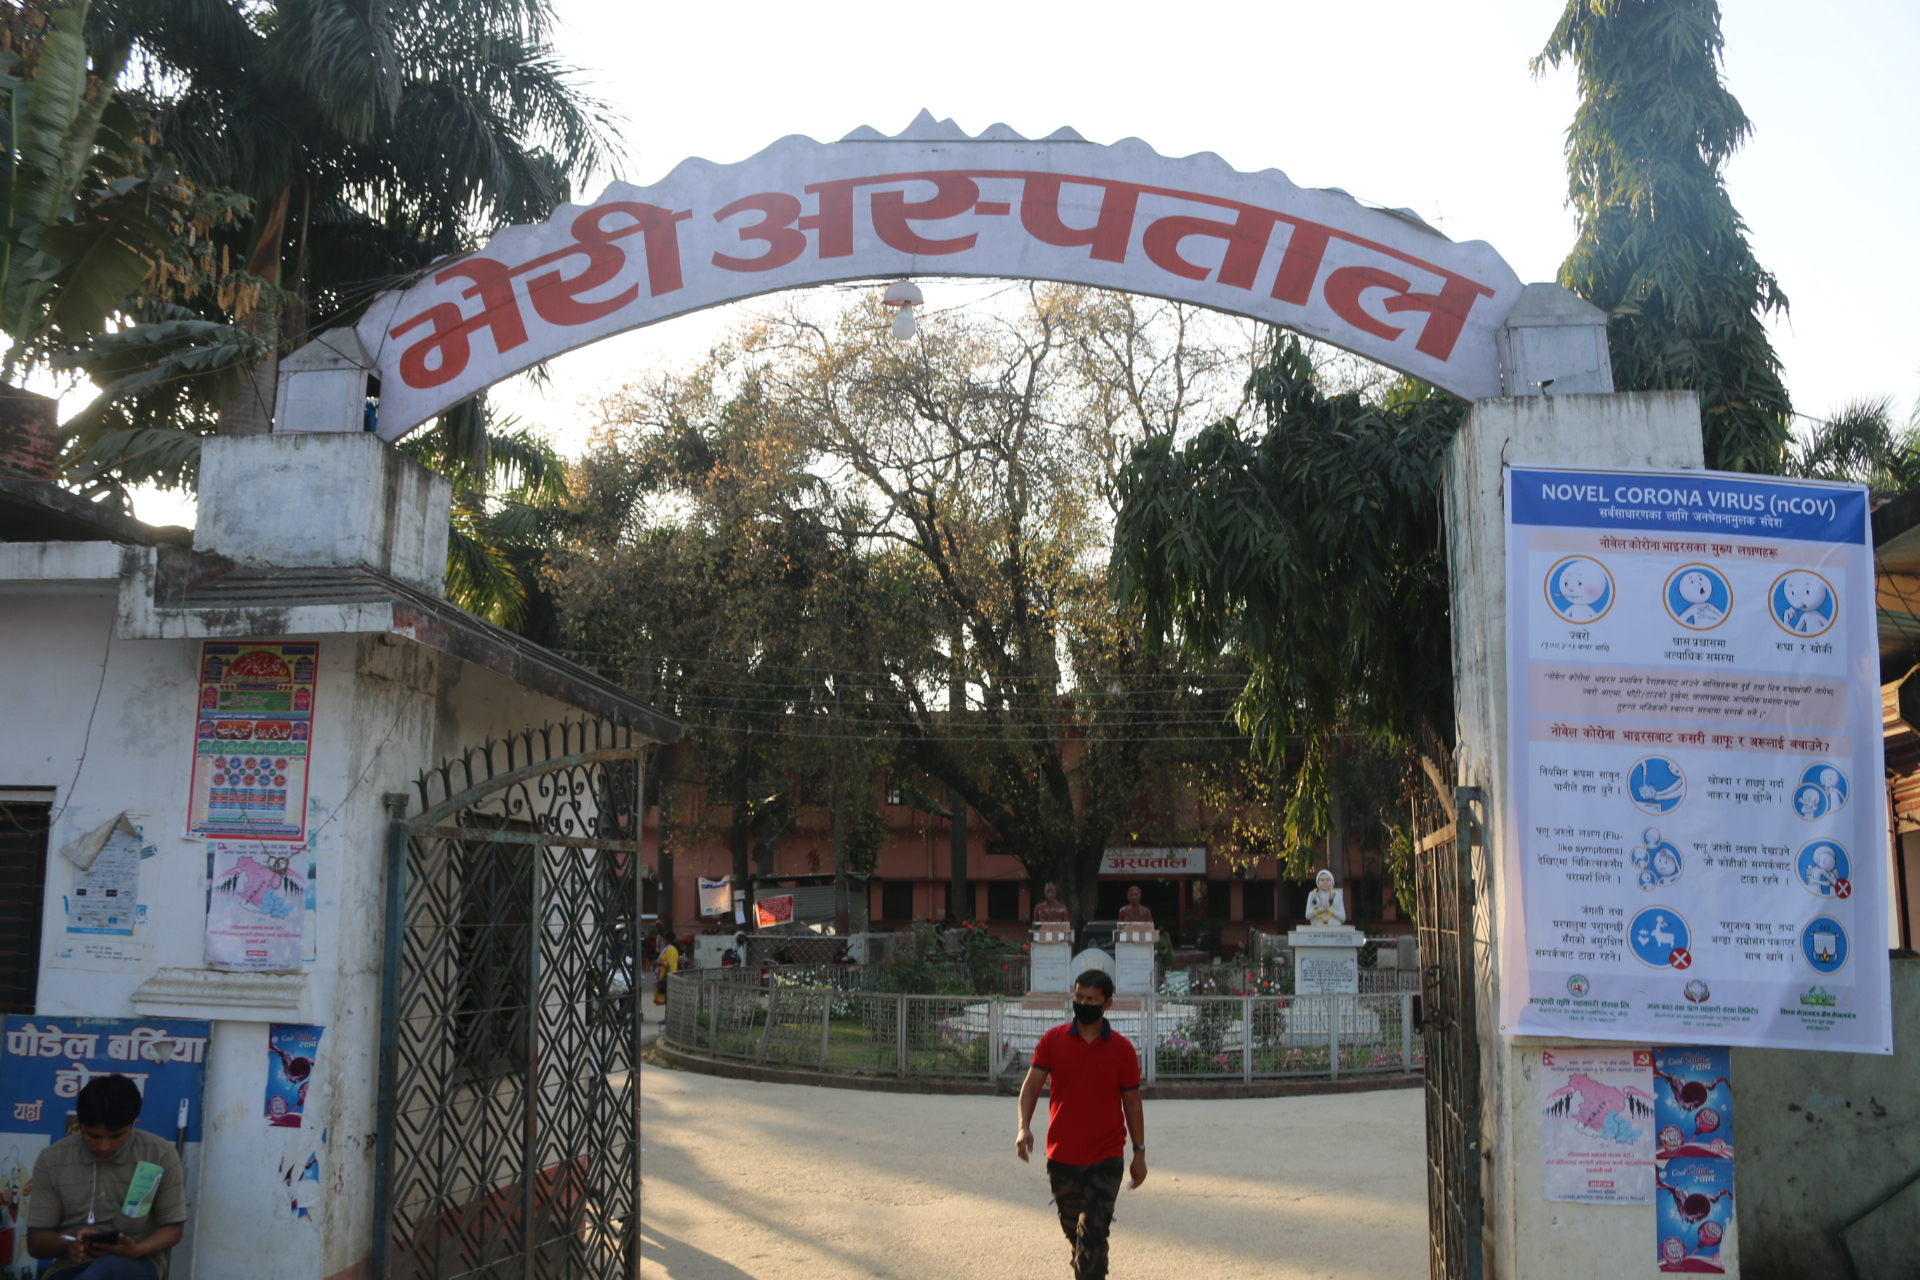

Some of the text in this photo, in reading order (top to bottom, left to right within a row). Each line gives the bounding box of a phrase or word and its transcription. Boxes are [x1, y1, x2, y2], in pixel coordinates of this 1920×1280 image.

[389, 170, 1496, 389] भेरी अस्पताल
[1542, 483, 1836, 521] NOVEL CORONA VIRUS (nCOV)
[1599, 505, 1662, 520] सर्वसाधारणका
[1666, 507, 1689, 522] लागि
[1599, 535, 1627, 549] नोबेल
[1628, 536, 1660, 551] कोरोना
[1662, 541, 1707, 553] भाइरसका
[1711, 543, 1733, 557] मुख्य
[1569, 629, 1590, 640] ज्वरो
[1800, 643, 1806, 653] र
[1811, 641, 1833, 655] खोकी
[1706, 652, 1735, 663] समस्या
[1550, 723, 1578, 738] नोबेल
[1583, 724, 1616, 740] कोरोना
[1622, 730, 1673, 743] भाइरसबाट
[1677, 730, 1706, 745] कसरी
[1738, 736, 1746, 748] र
[1539, 764, 1568, 777] नियमित
[1554, 781, 1578, 793] पानीले
[1581, 784, 1596, 794] हात
[1601, 783, 1614, 797] धुने
[1736, 777, 1742, 787] र
[1769, 778, 1784, 789] गर्दा
[1707, 790, 1723, 800] नाक
[1725, 791, 1731, 801] र
[1734, 791, 1749, 804] मुख
[1553, 826, 1574, 838] जस्तो
[1579, 828, 1600, 839] लक्षण
[1602, 830, 1623, 841] (Flu-
[1558, 843, 1623, 857] like symptoms)
[1711, 841, 1732, 853] जस्तो
[1735, 844, 1757, 855] लक्षण
[1761, 843, 1790, 857] देखाउने
[1108, 858, 1188, 869] अस्पताल
[1537, 853, 1568, 868] देखिएमा
[1703, 855, 1791, 872] जो कोहीको सम्पर्कबाट
[1566, 871, 1593, 883] परामर्श
[1595, 871, 1611, 883] लिने
[1740, 874, 1758, 885] टाढा
[1762, 873, 1779, 886] रहने
[1608, 907, 1624, 917] तथा
[1552, 919, 1587, 932] घरपालुवा
[1719, 921, 1795, 935] पशुजन्य मासु तथा
[1590, 935, 1623, 949] असुरक्षित
[1711, 936, 1731, 946] अन्डा
[1767, 937, 1796, 949] पकाएर
[1535, 946, 1574, 960] सम्पर्कबाट
[1578, 951, 1595, 961] टाढा
[1744, 951, 1761, 961] मात्र
[1766, 950, 1783, 962] खाने
[1573, 998, 1599, 1008] सहकारी
[6, 1023, 100, 1060] पौडेल
[1668, 1057, 1682, 1066] Cool
[13, 1099, 44, 1122] यहाँ
[1671, 1168, 1686, 1177] Cool
